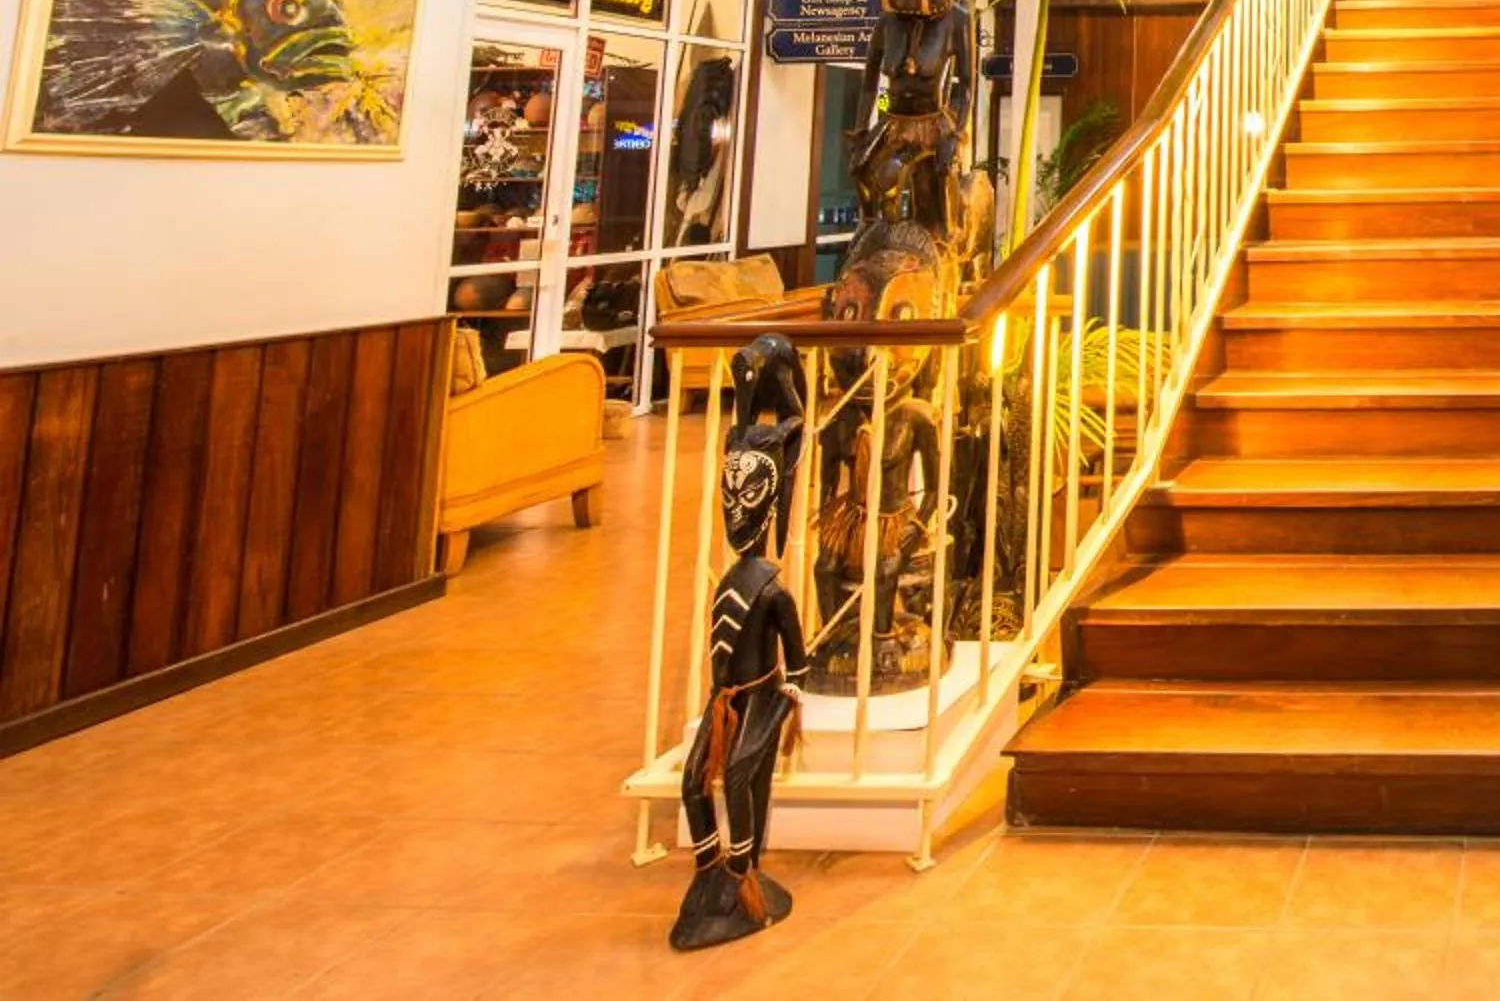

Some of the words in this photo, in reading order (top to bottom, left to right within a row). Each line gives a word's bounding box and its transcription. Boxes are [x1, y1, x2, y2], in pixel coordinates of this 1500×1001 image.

[800, 4, 867, 19] Newsagency
[793, 32, 856, 44] Melanesian
[857, 32, 873, 43] Ar
[815, 44, 855, 58] Gallery
